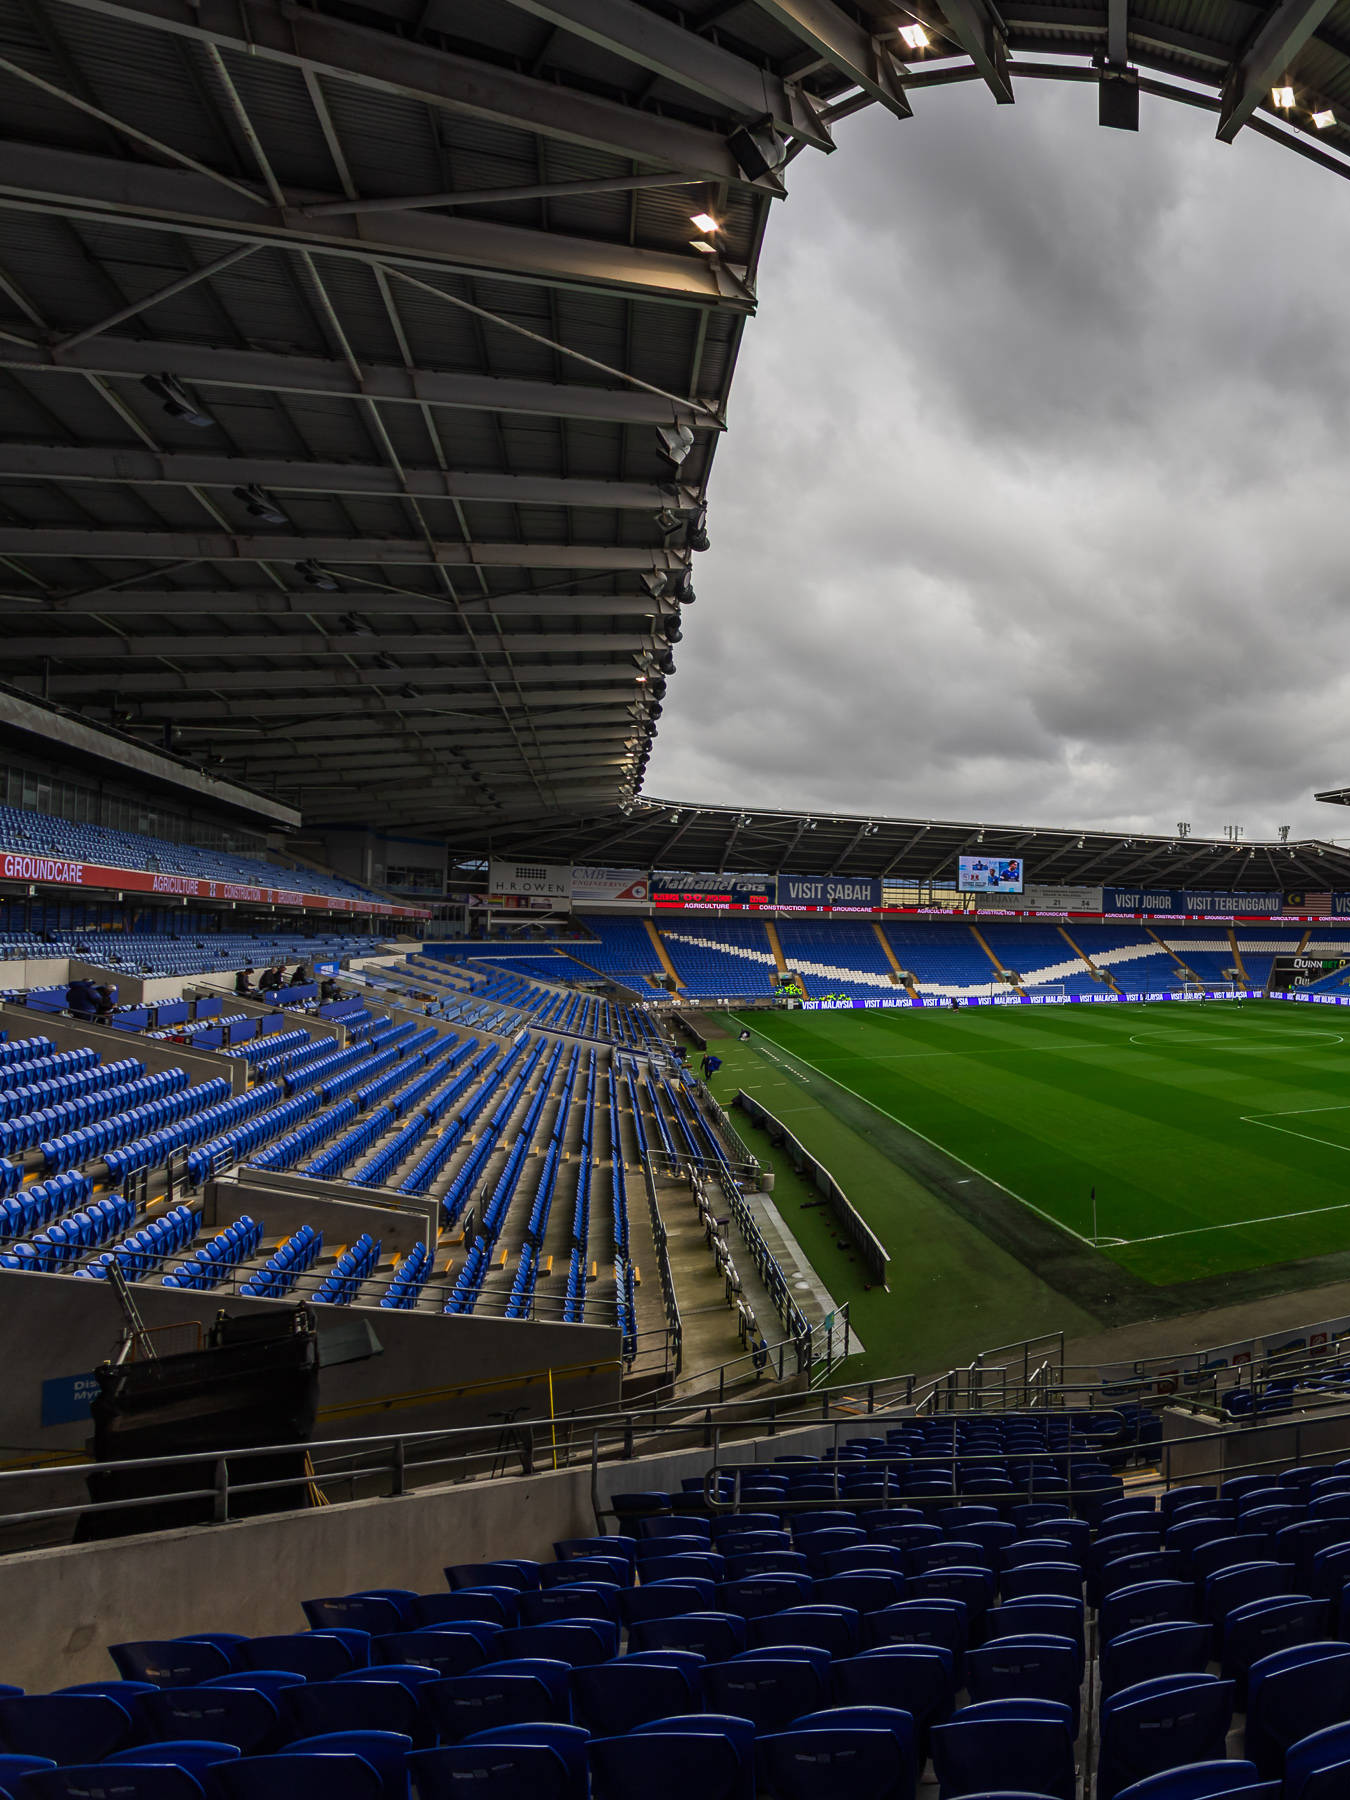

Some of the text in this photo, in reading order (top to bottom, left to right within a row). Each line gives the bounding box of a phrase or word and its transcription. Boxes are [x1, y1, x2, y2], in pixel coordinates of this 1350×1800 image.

[4, 855, 83, 883] GROUNDCARE
[572, 868, 605, 880] CMB
[153, 875, 199, 895] AGRICULTURE
[224, 884, 261, 901] CONSTRUCTION
[572, 879, 628, 888] ENGINEERING
[789, 882, 872, 900] VISIT SABAH
[1115, 893, 1140, 908] VISIT
[1141, 895, 1171, 909] JOHOR
[1187, 896, 1279, 911] VISIT TERENGGANU
[684, 902, 730, 910] AGRICULTURE
[922, 997, 968, 1006] VISIT MALYSIA
[978, 996, 1021, 1005] VISIT MALAYSIA
[1030, 995, 1071, 1004] VISIT MALAYSIA
[1080, 994, 1119, 1002] VISIT MALAYSIA
[802, 1000, 853, 1010] VISIT MALAYSIA
[864, 999, 913, 1008] VISIT MALAYSIA
